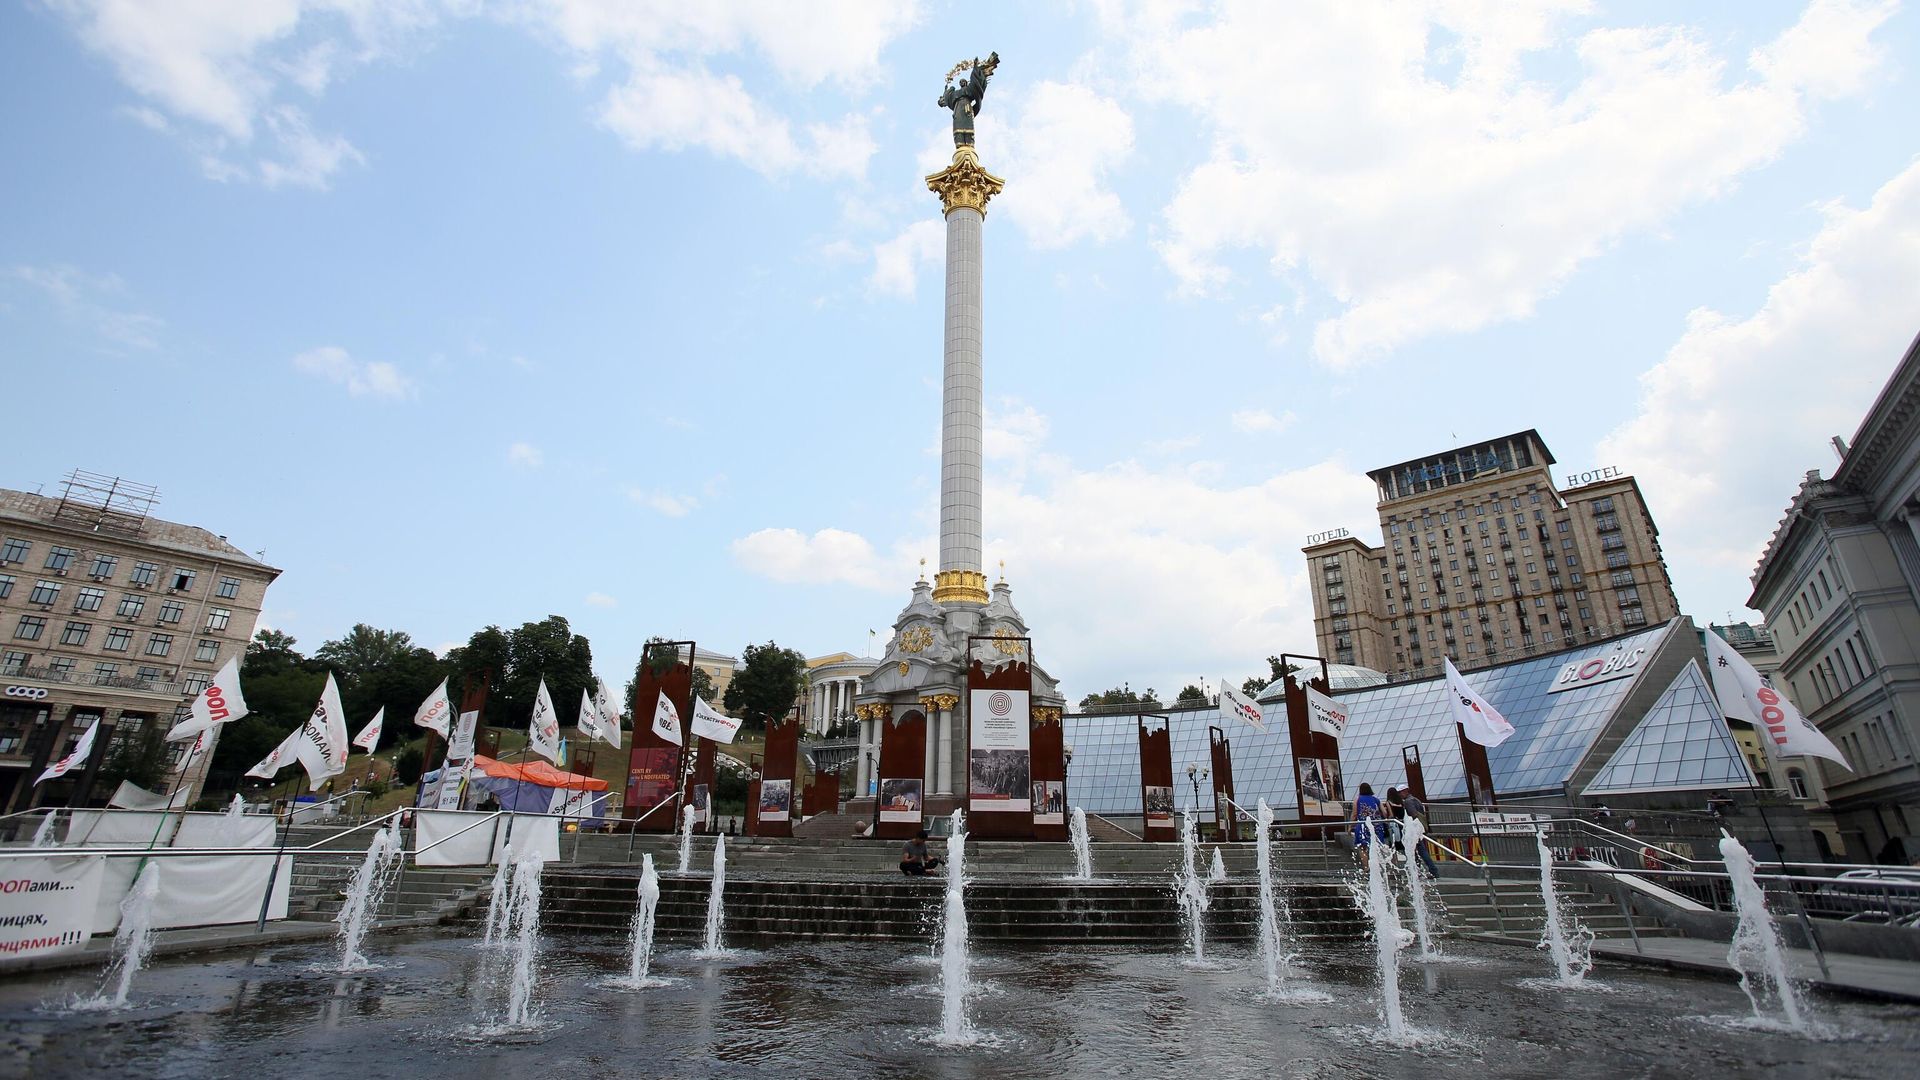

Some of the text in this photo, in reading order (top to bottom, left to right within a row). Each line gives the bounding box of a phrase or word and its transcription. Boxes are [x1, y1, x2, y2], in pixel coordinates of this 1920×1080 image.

[1567, 466, 1623, 486] HOTEL
[1306, 527, 1349, 545] ГОТЕЛЬ
[1560, 648, 1644, 684] GLOBUS
[5, 686, 48, 700] coop
[0, 880, 74, 893] ОПами...
